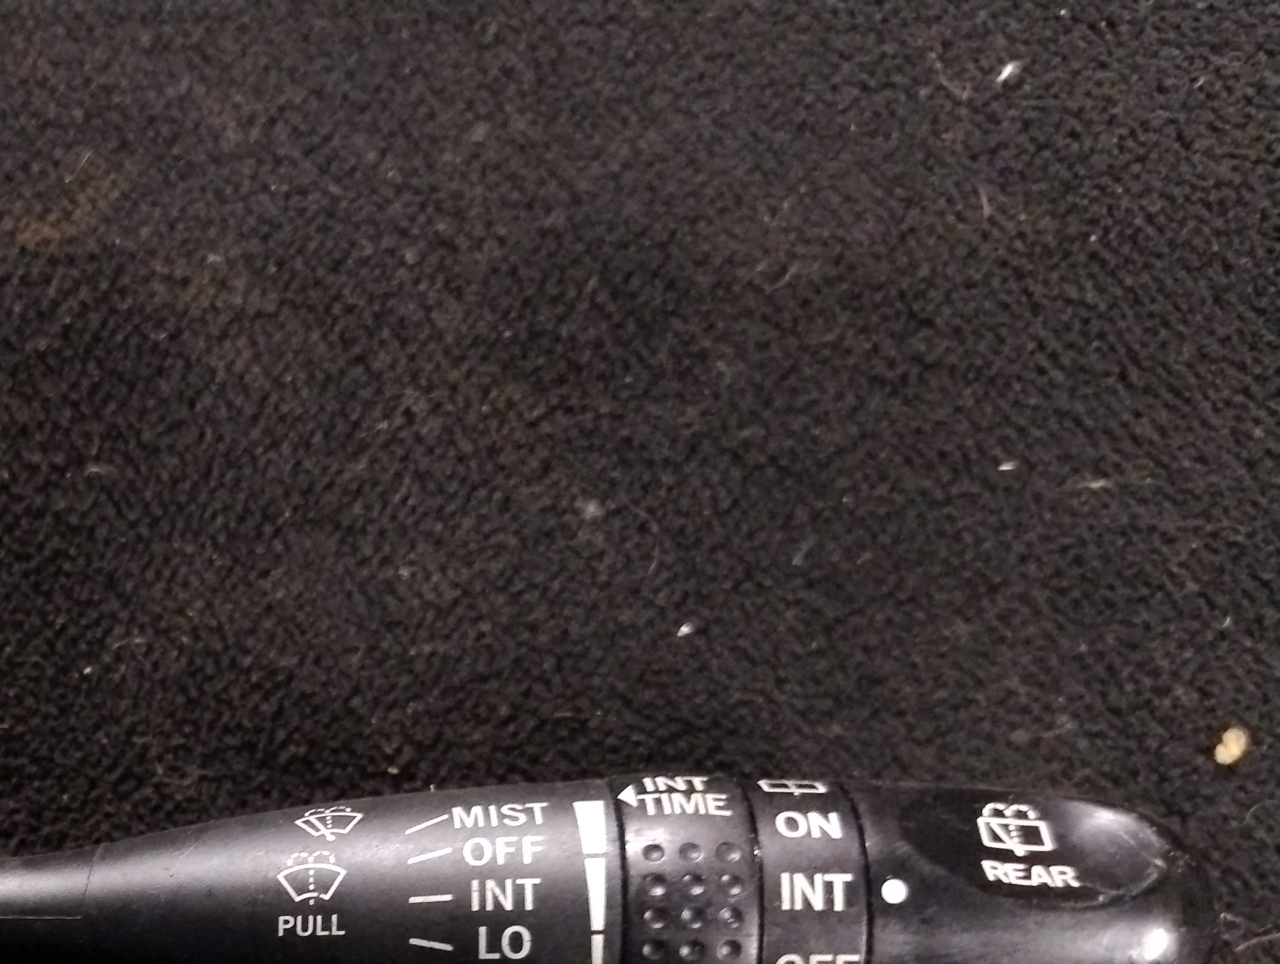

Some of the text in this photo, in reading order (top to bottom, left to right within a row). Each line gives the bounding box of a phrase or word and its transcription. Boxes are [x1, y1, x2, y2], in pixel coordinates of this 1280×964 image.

[642, 775, 710, 792] INT
[451, 801, 549, 830] MIST
[637, 791, 734, 818] TIME
[774, 810, 843, 840] ON
[462, 836, 545, 867] OFF
[980, 859, 1083, 889] REAR
[470, 877, 542, 913] INT
[780, 872, 854, 912] INT
[277, 914, 346, 937] PULL
[478, 925, 533, 960] LO
